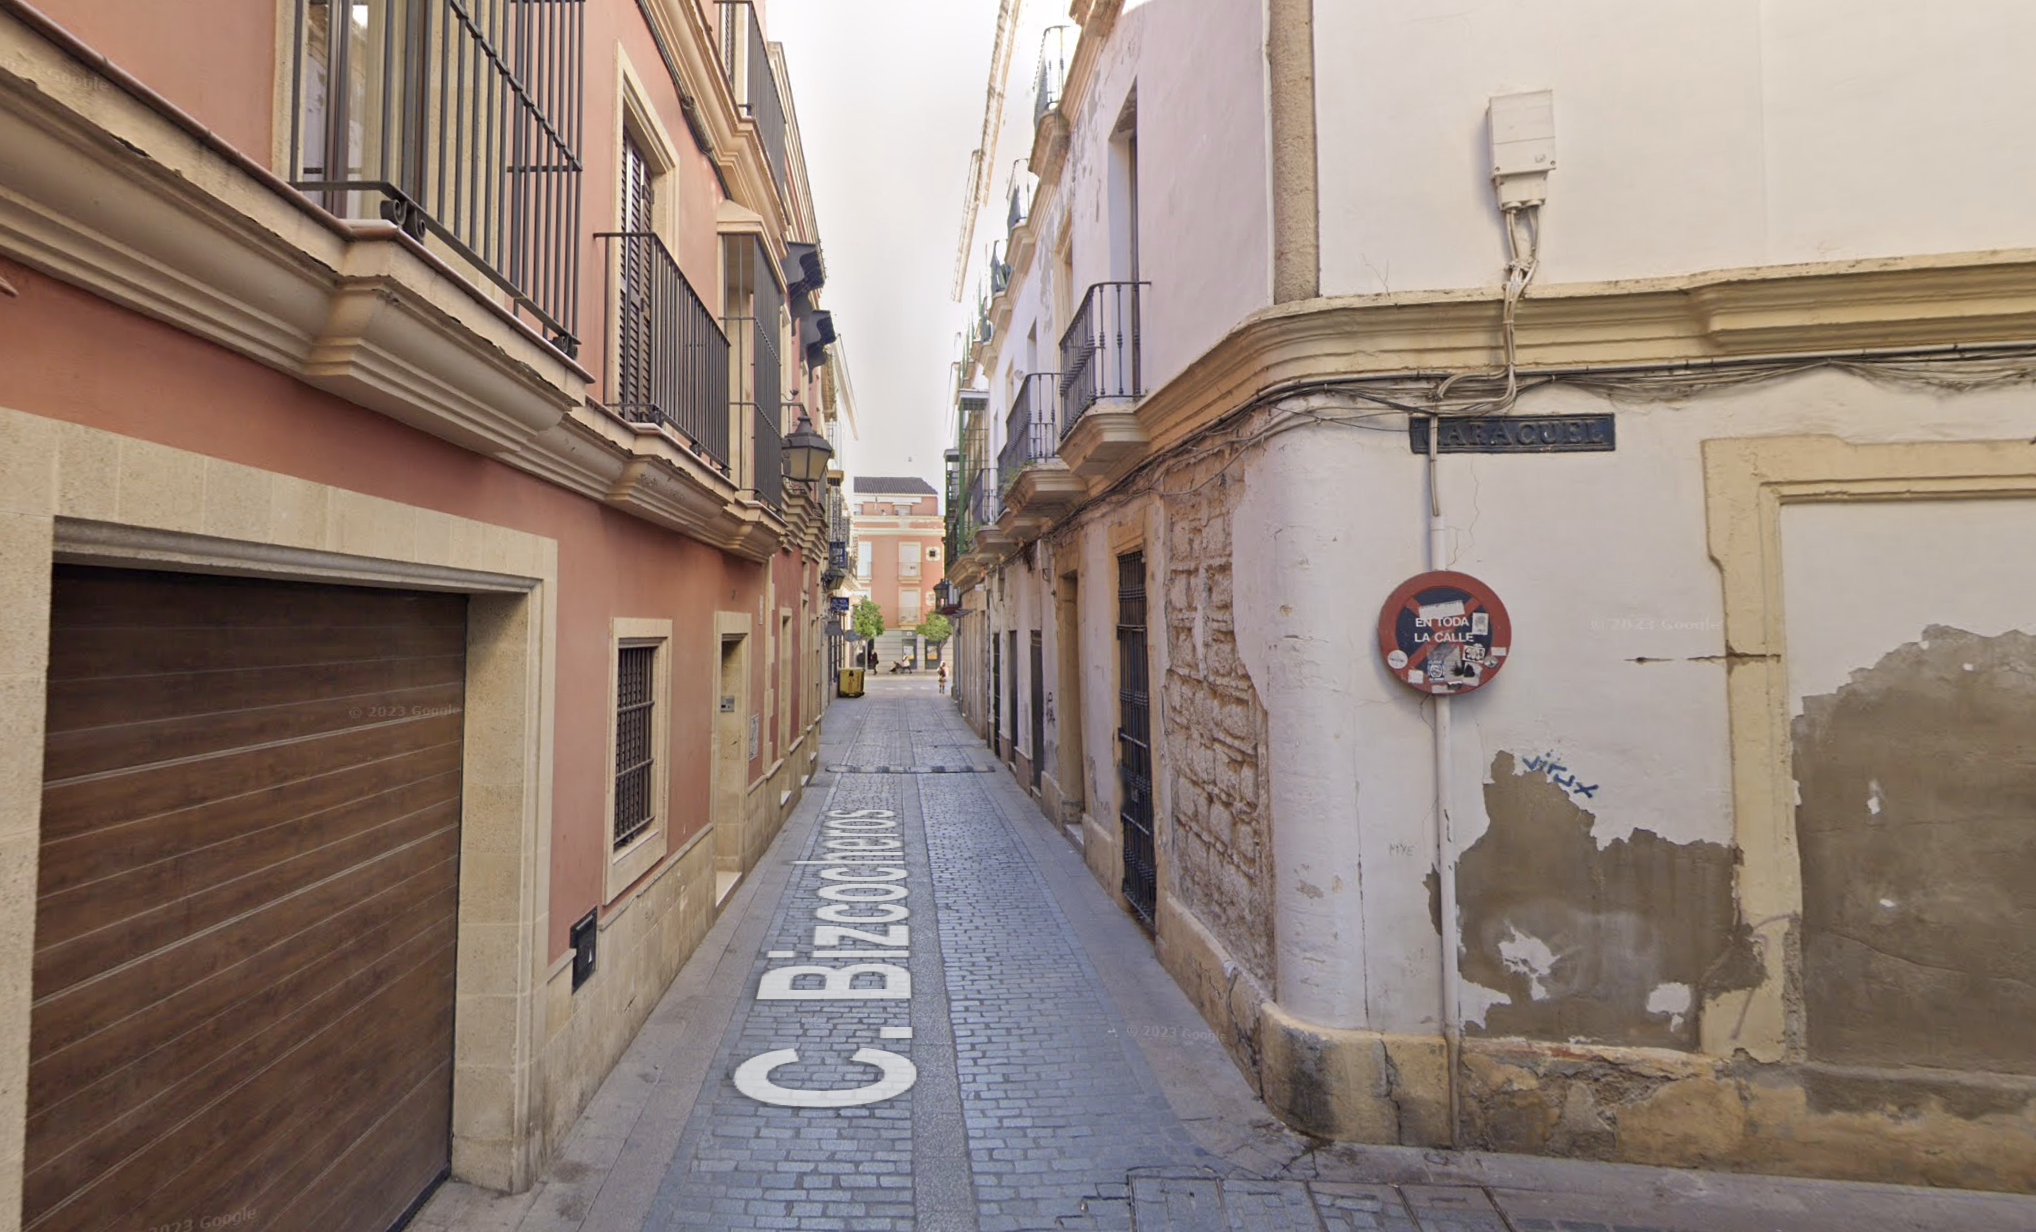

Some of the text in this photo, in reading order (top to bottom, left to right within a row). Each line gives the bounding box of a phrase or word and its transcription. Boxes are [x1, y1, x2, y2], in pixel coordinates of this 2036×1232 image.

[1415, 617, 1470, 628] EN TODA
[1414, 632, 1474, 642] LA CALLE
[733, 809, 917, 1107] C. Bizcocheros
